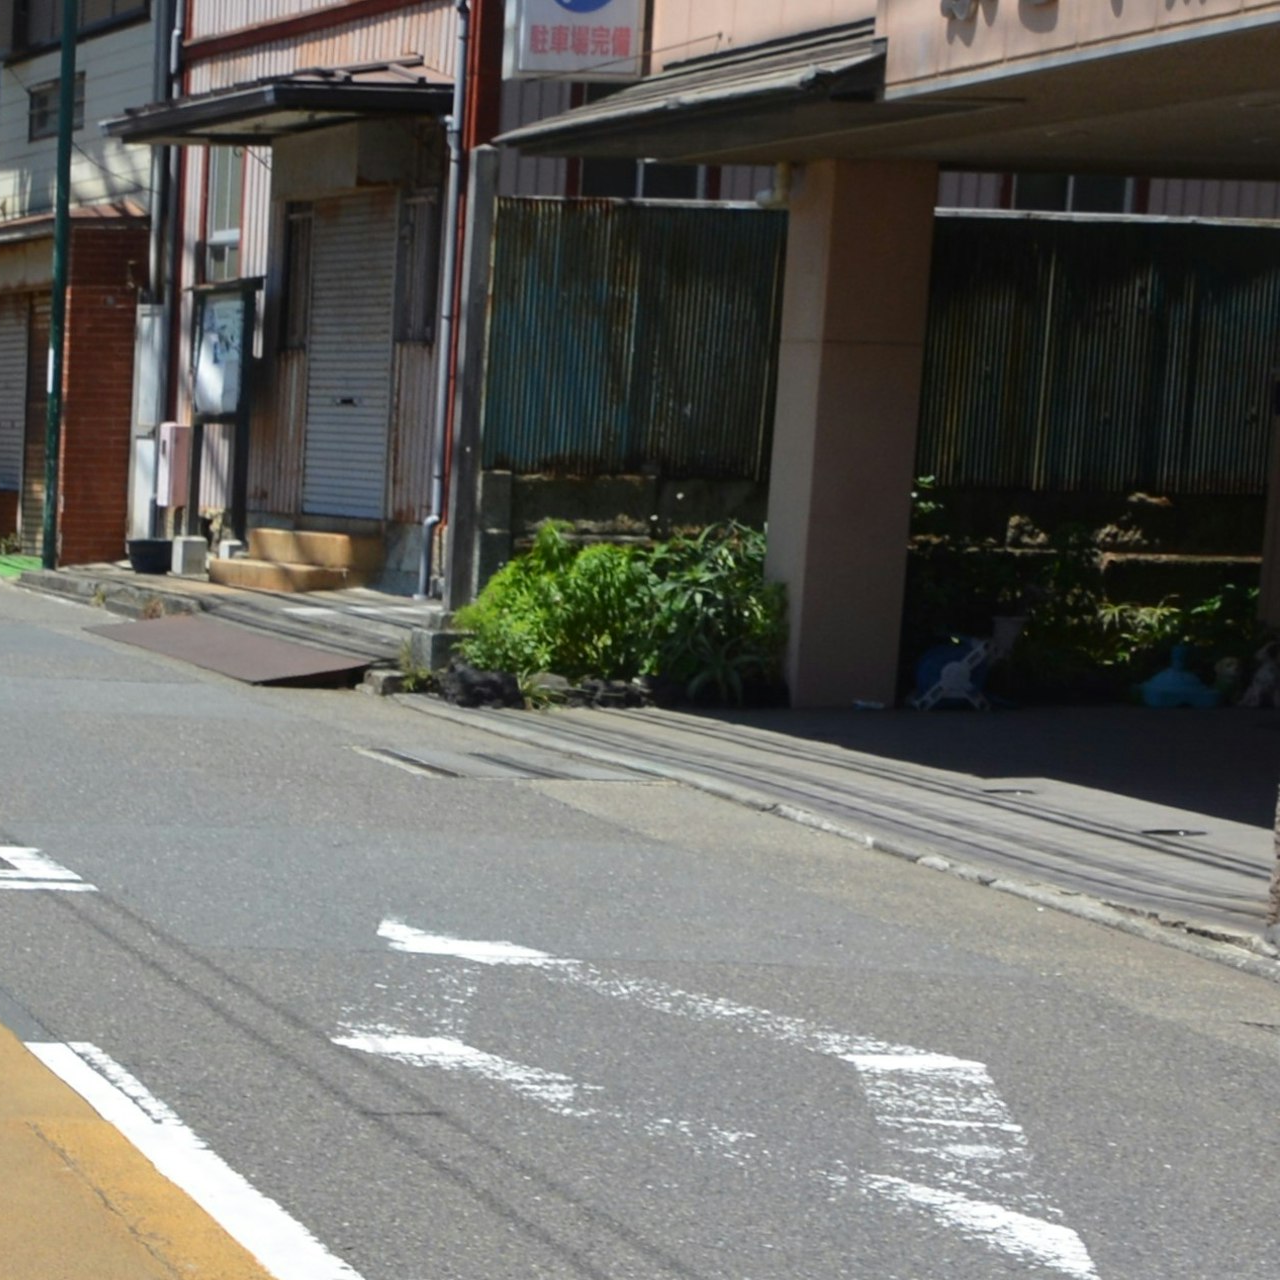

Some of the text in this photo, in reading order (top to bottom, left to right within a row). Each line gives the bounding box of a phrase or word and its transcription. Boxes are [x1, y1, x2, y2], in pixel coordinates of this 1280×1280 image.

[530, 25, 632, 56] 駐車場完備
